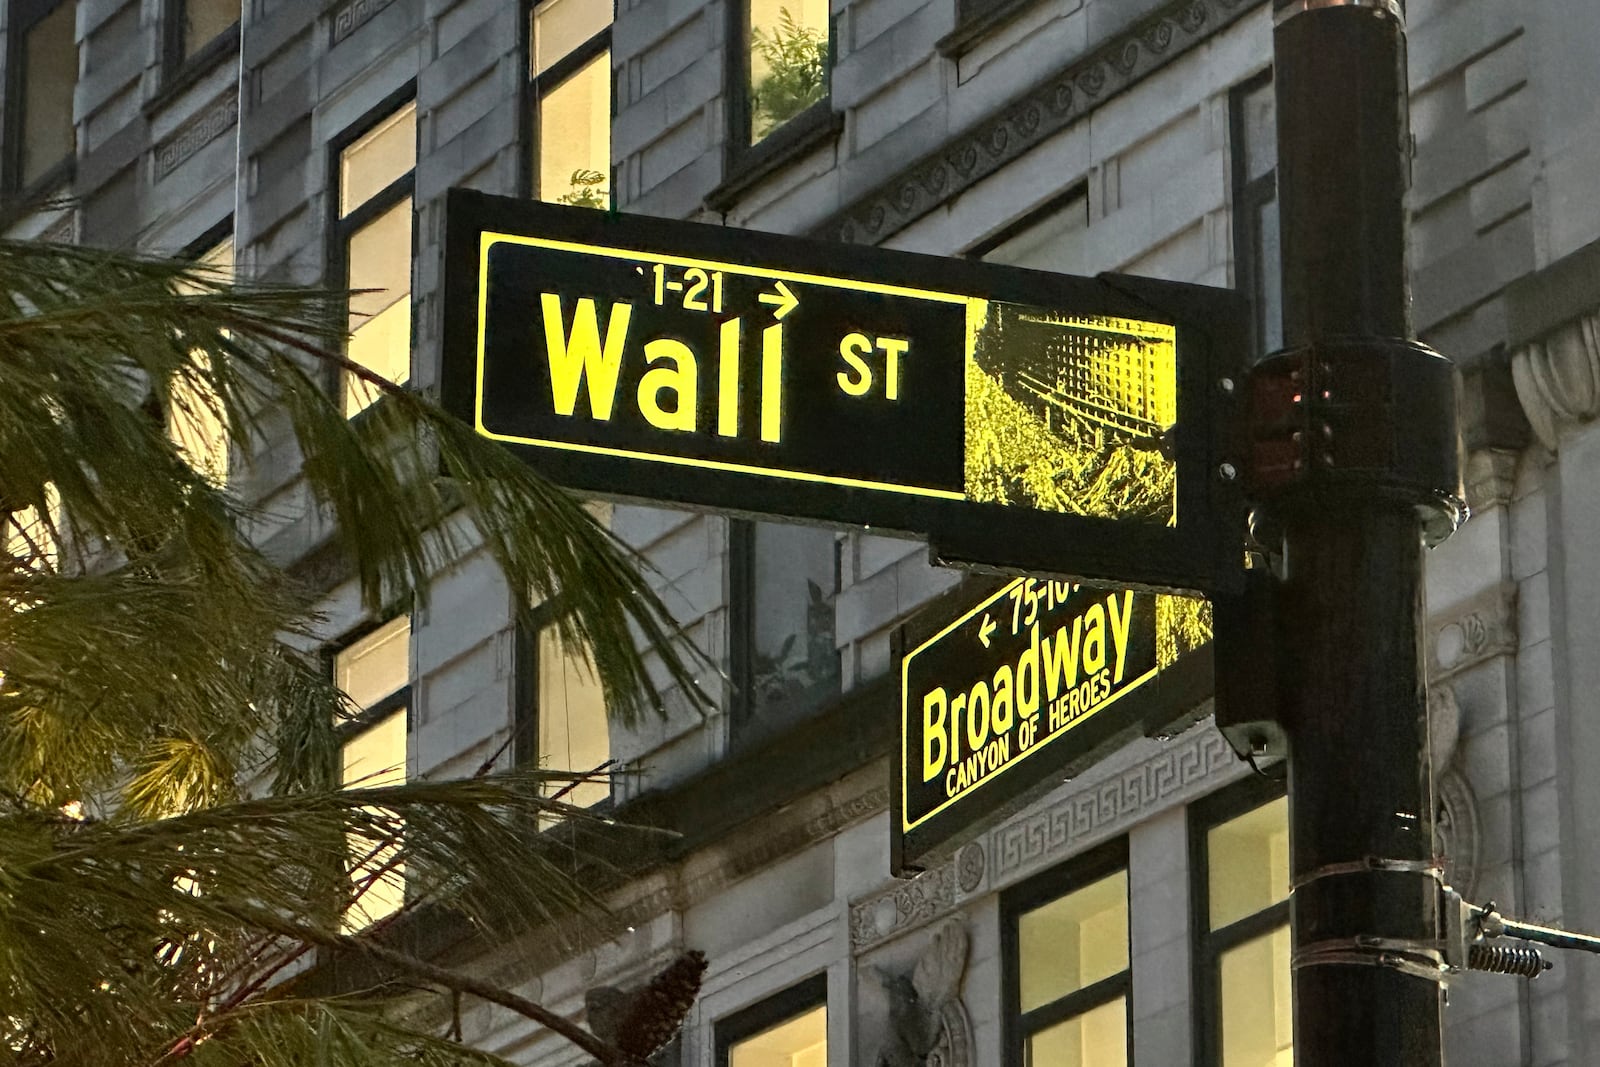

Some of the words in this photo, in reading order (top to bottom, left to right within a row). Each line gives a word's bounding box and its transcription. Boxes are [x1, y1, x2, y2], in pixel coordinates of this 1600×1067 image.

[653, 263, 723, 314] 1-21
[540, 292, 783, 443] Wall
[836, 332, 909, 401] ST
[923, 589, 1134, 783] Broadway
[945, 732, 1010, 798] CANYON
[1018, 713, 1040, 751] OF
[1049, 668, 1111, 733] HEROES
